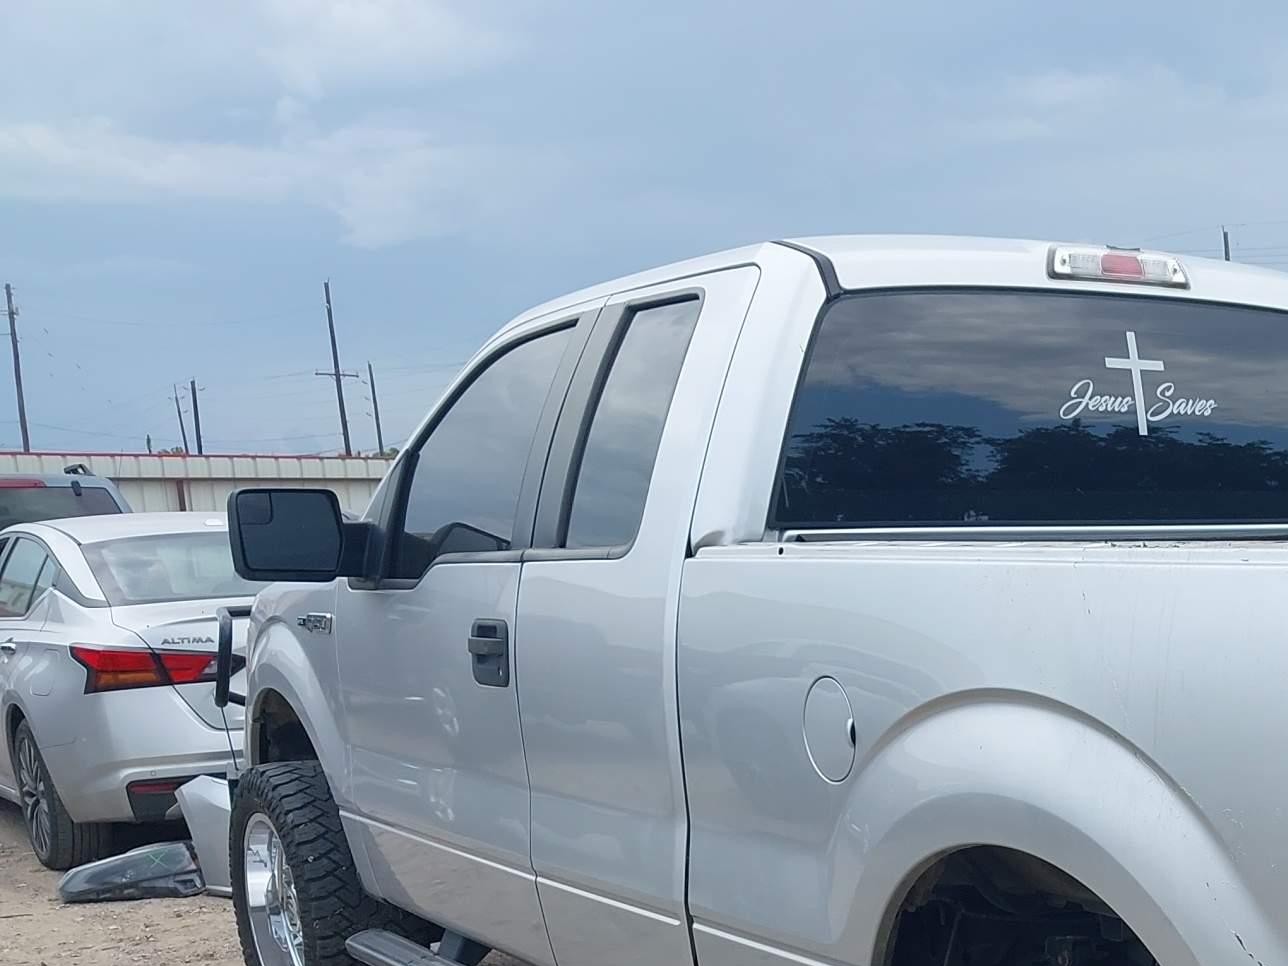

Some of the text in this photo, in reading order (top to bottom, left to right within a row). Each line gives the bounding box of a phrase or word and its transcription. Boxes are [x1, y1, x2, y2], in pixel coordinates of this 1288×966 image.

[1060, 379, 1218, 421] Jesus Saves
[160, 636, 215, 646] ALTIMA
